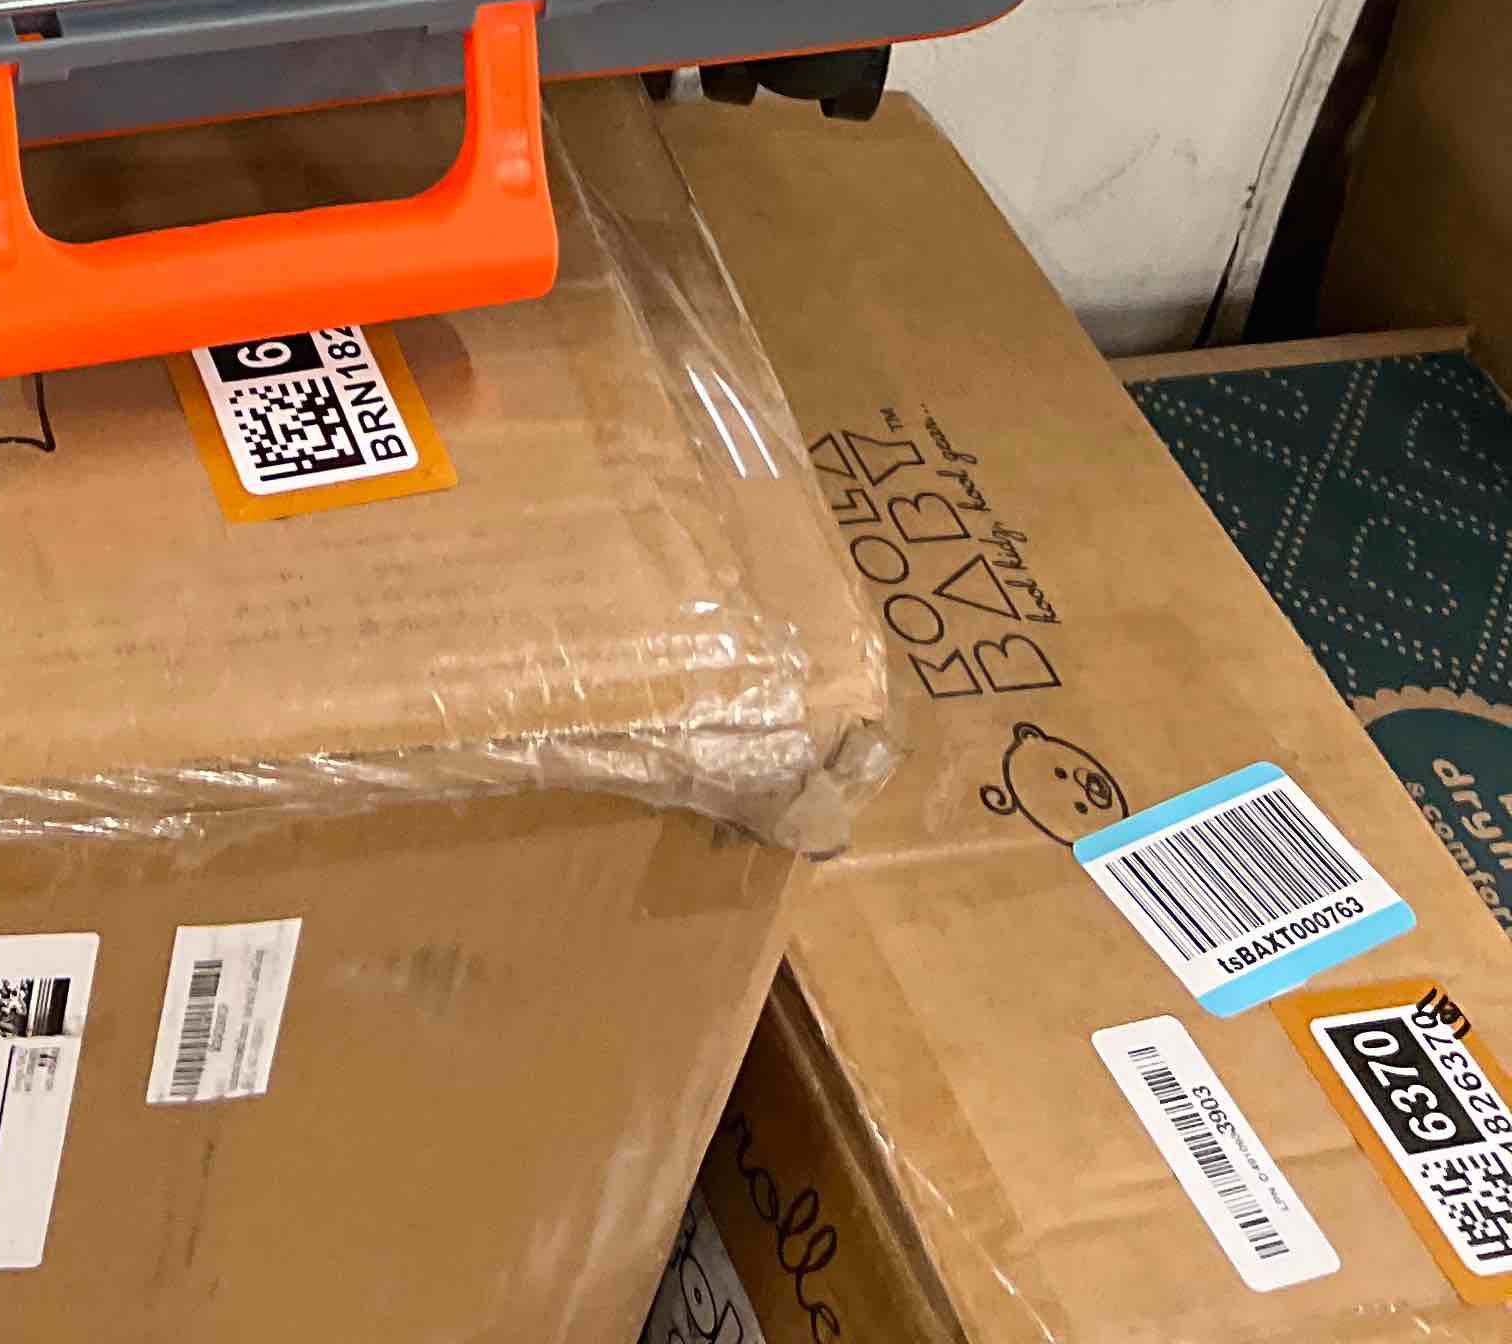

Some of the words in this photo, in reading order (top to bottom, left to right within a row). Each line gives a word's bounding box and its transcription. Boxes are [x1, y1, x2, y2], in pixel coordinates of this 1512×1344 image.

[842, 429, 1062, 694] BABY
[1216, 894, 1366, 976] tsBAXT000763
[1351, 1028, 1458, 1144] 6370
